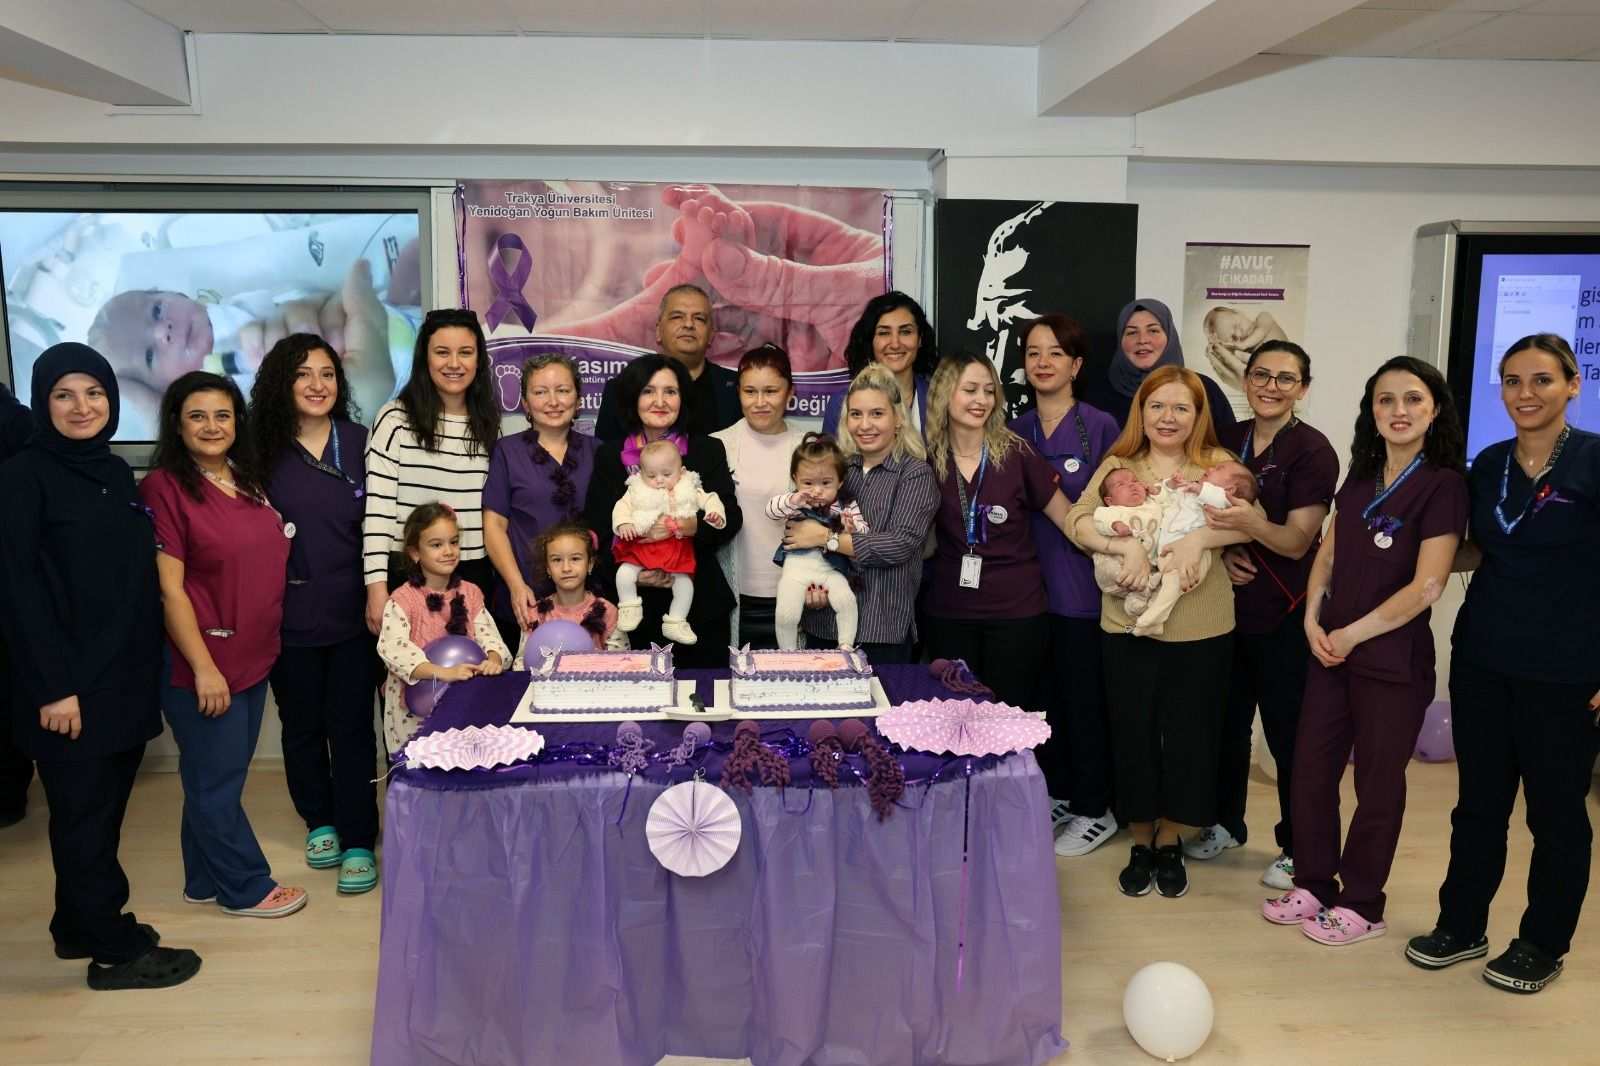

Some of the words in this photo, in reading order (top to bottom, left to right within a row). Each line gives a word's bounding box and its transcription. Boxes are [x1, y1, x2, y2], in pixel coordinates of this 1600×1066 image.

[505, 191, 545, 205] Trakya
[547, 191, 616, 204] Üniversitesi
[468, 206, 530, 219] Yenidoğan
[532, 207, 570, 219] Yoğun
[573, 207, 609, 218] Bakım
[613, 208, 653, 219] Ünitesi
[1220, 255, 1273, 273] #AVUÇ
